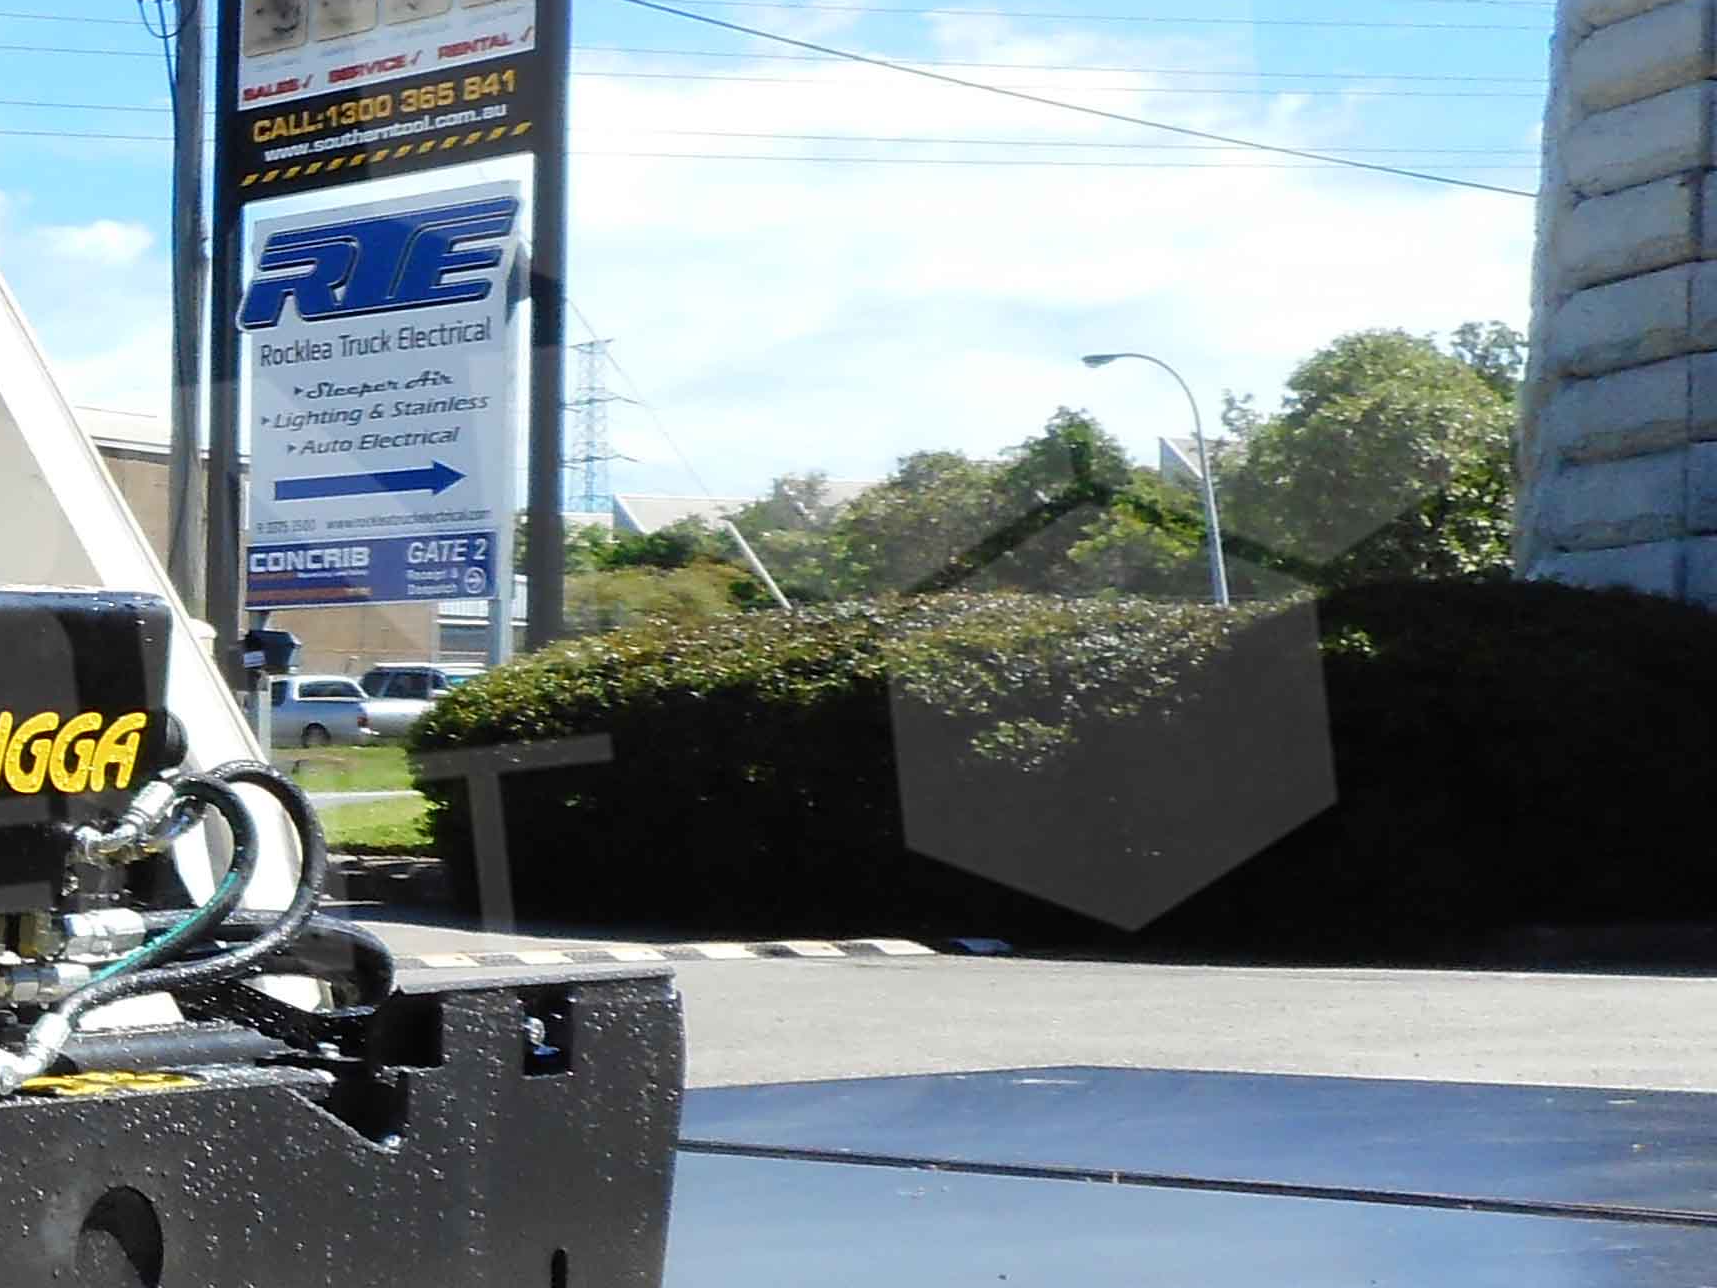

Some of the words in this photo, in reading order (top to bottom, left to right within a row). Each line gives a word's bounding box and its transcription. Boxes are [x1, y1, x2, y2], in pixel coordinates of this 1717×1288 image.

[243, 78, 300, 102] SALES
[328, 55, 407, 84] SERVICE
[437, 33, 513, 60] RENTAL
[400, 81, 455, 113] 365
[464, 69, 517, 100] 841
[265, 103, 508, 162] www.southerntool.com.au
[260, 339, 333, 367] Rocklea
[338, 330, 392, 358] Truck
[396, 316, 492, 350] Electrical
[306, 379, 399, 401] Sleeper
[404, 369, 454, 390] Air
[273, 405, 364, 432] Lighting
[368, 402, 388, 420] &
[392, 394, 491, 418] Stainless
[299, 437, 354, 457] Auto
[359, 426, 461, 451] Electrical
[249, 546, 370, 574] CONCRIB
[406, 538, 468, 564] GATE
[473, 538, 487, 561] 2
